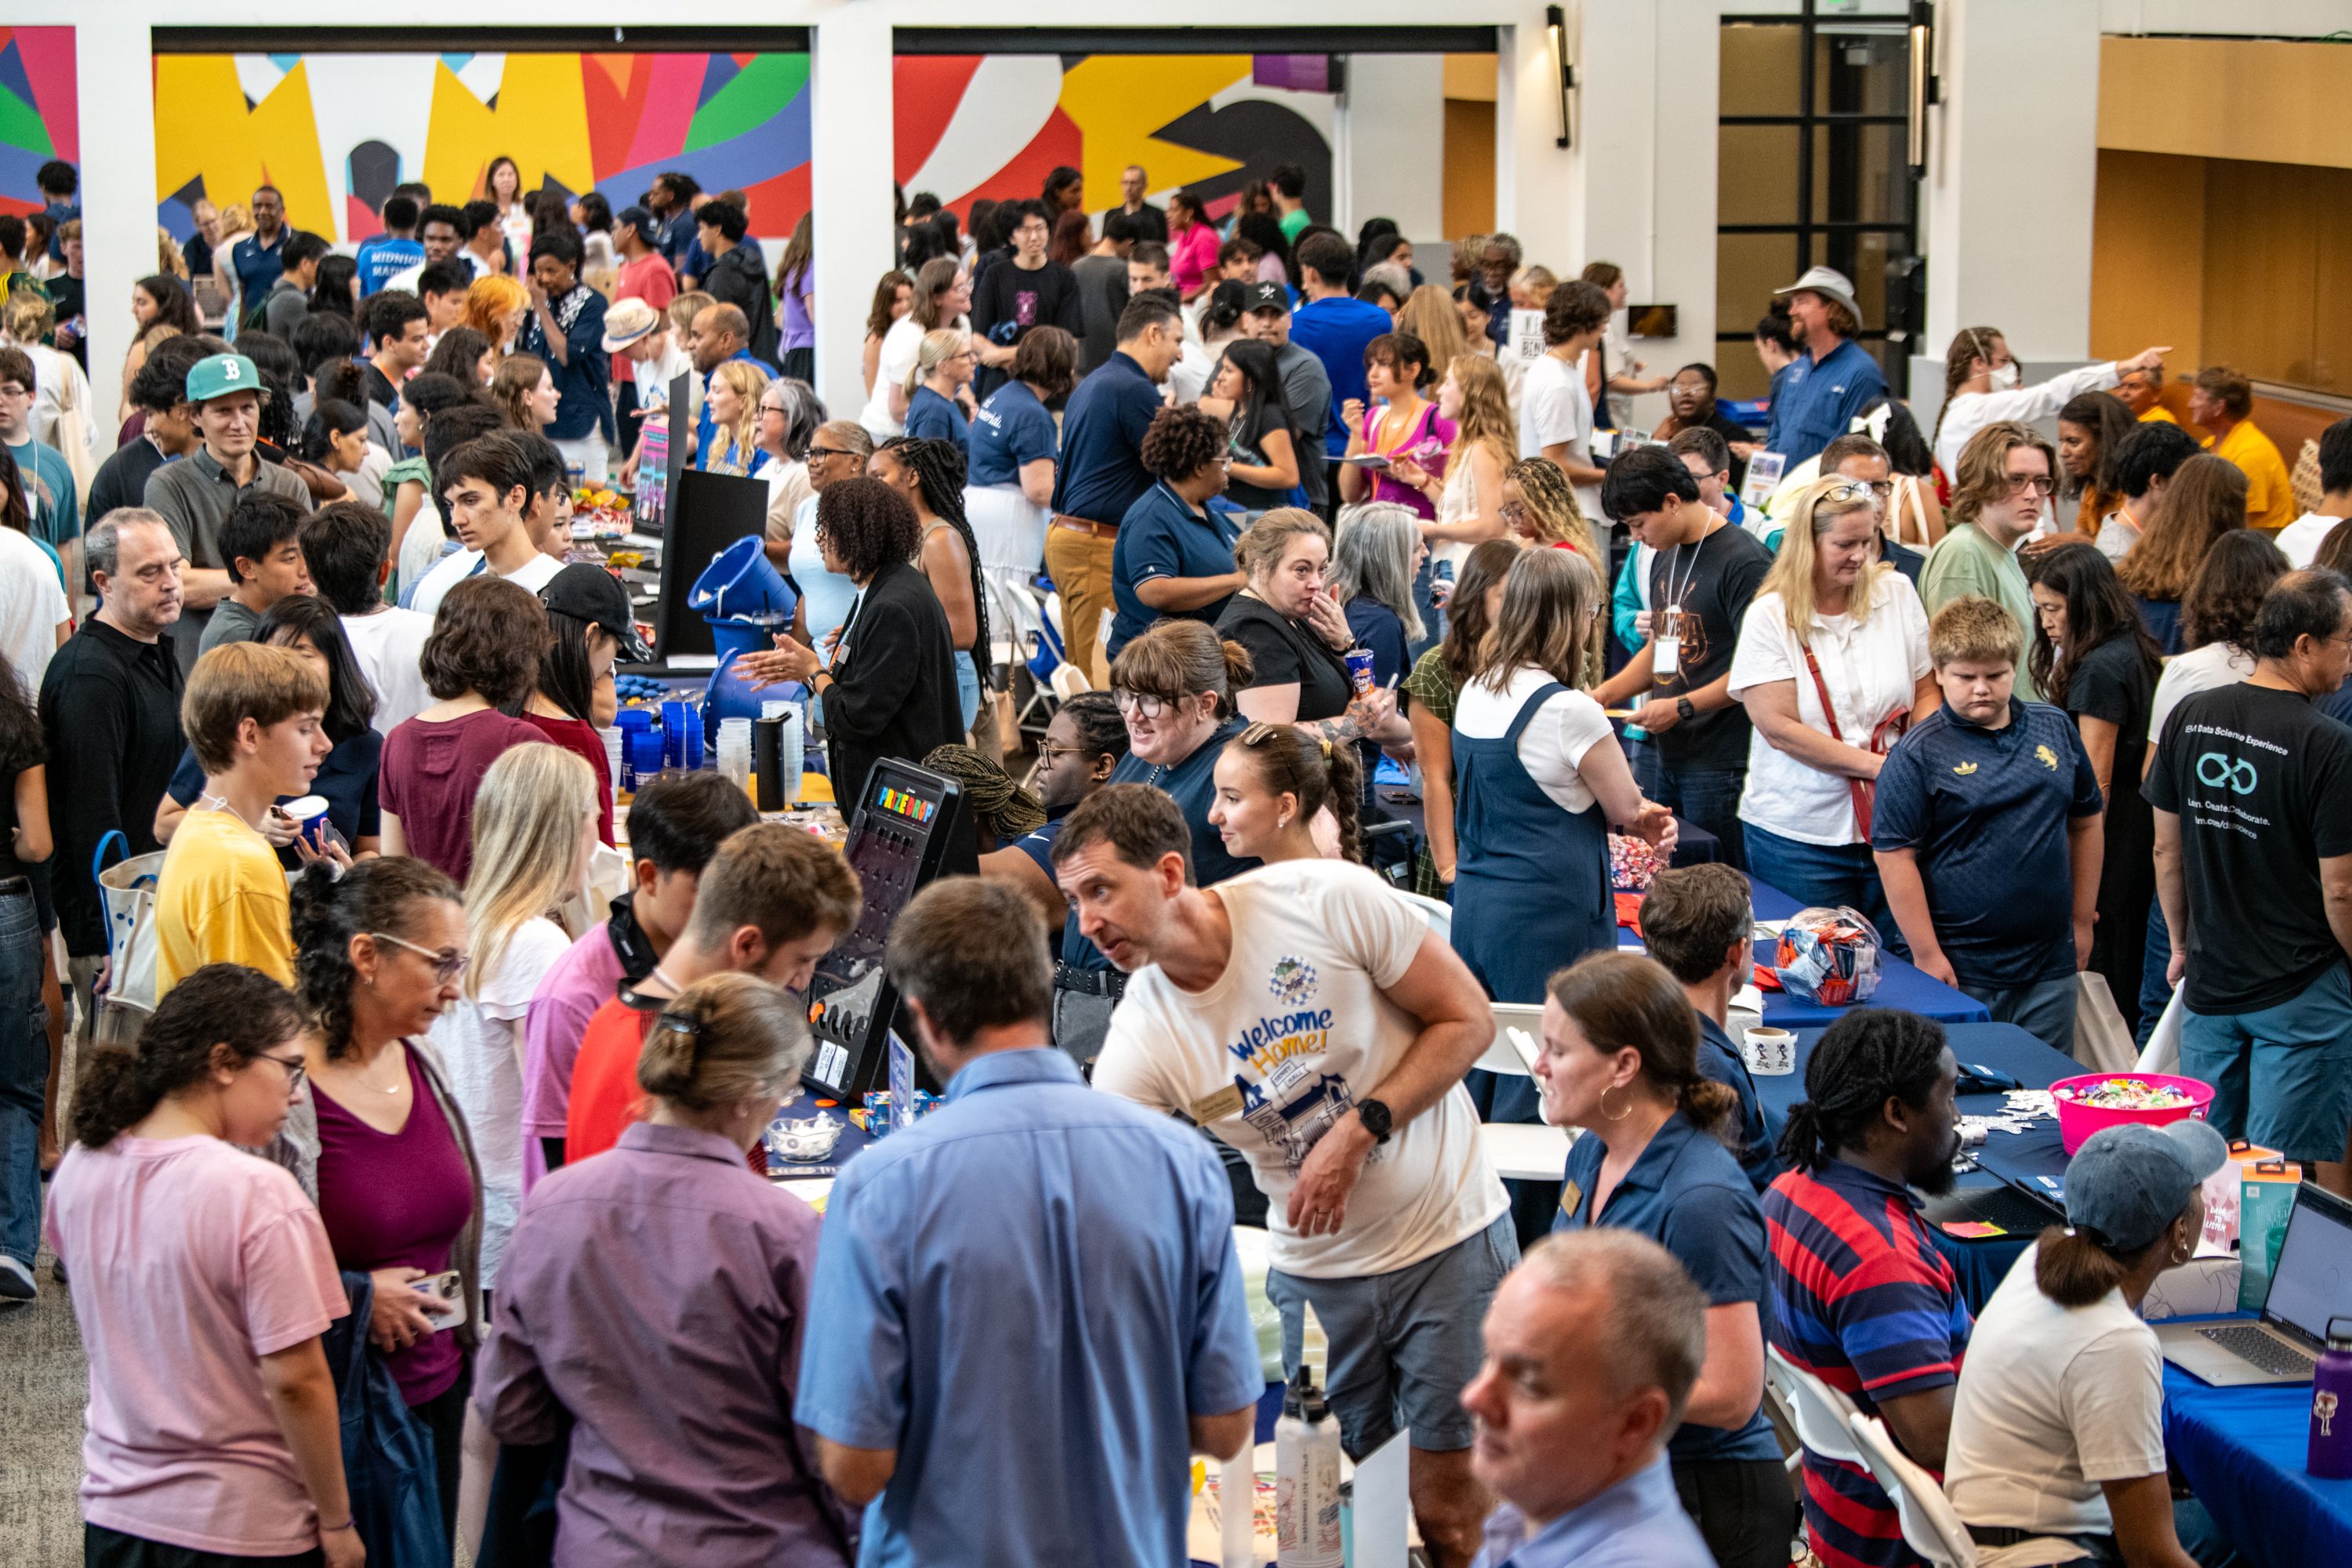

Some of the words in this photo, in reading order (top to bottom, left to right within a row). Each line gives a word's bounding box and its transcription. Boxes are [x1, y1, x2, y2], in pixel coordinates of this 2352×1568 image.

[221, 358, 241, 381] B
[2198, 723, 2215, 735] Data
[2245, 735, 2289, 756] Experience
[1228, 1008, 1334, 1062] Welcome
[1249, 1029, 1327, 1077] Home!
[2205, 1221, 2226, 1232] LISTEN
